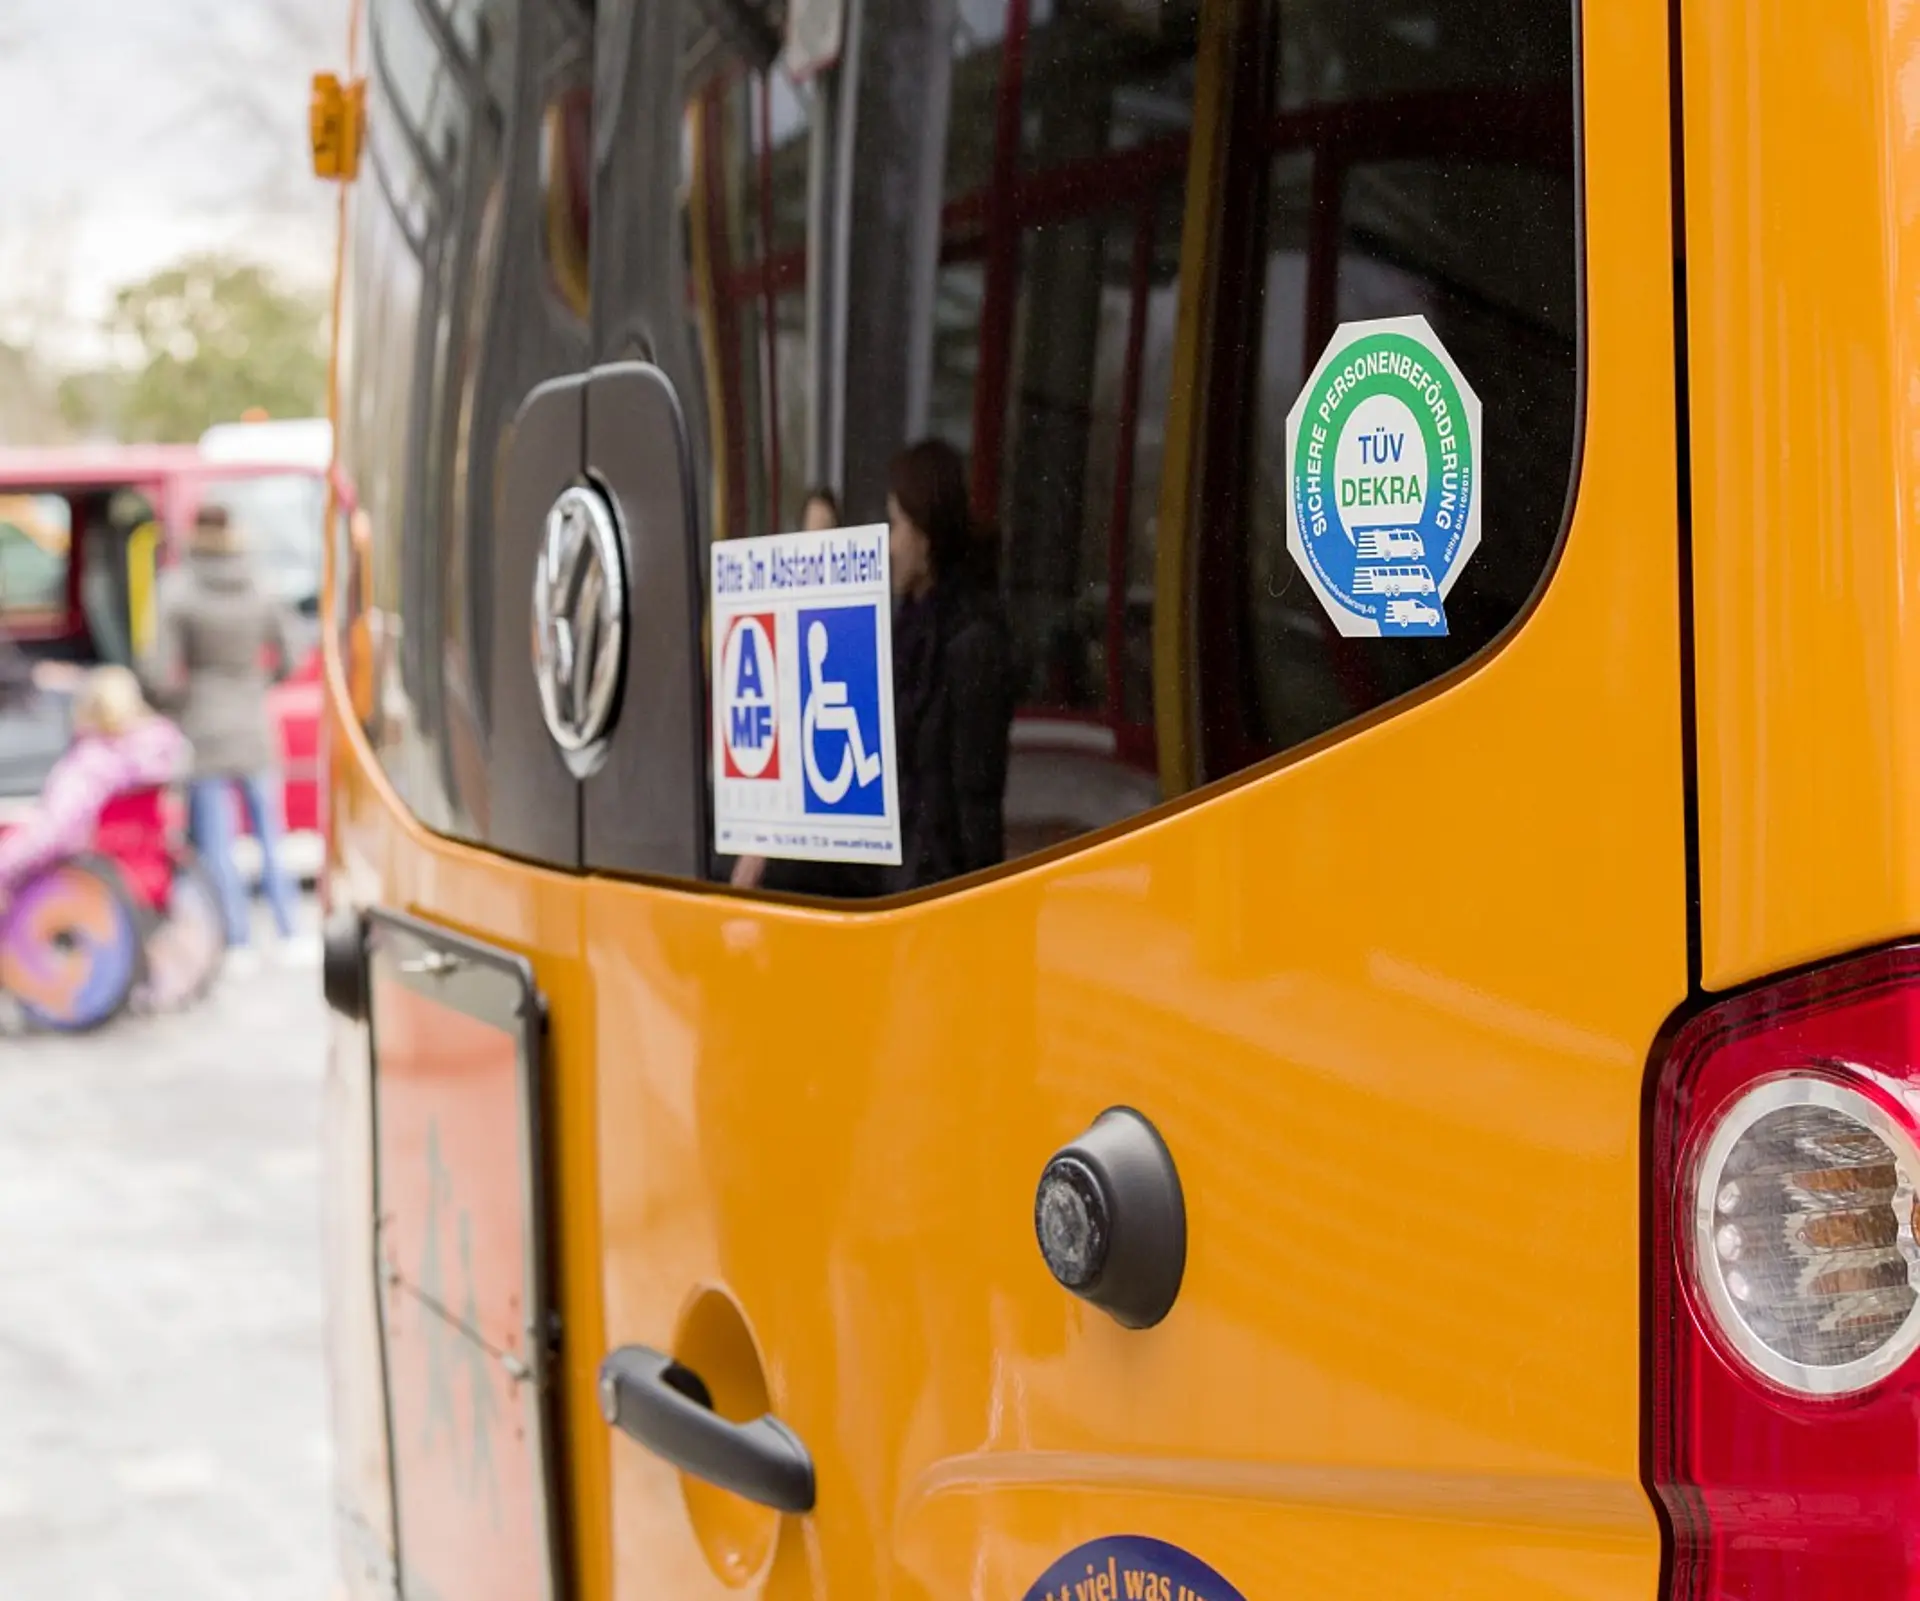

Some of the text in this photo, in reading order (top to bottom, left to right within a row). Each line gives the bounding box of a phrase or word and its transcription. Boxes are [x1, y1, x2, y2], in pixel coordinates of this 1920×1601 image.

[1306, 350, 1459, 537] SICHERE PERSONENBEFÖRDERUNG
[1357, 426, 1405, 465] TÜV
[1341, 473, 1423, 507] DEKRA
[770, 541, 826, 590] Abstand
[830, 535, 883, 585] halten!
[736, 627, 764, 699] A
[731, 704, 772, 749] MF
[1075, 1556, 1118, 1601] viel
[1123, 1570, 1172, 1601] was
